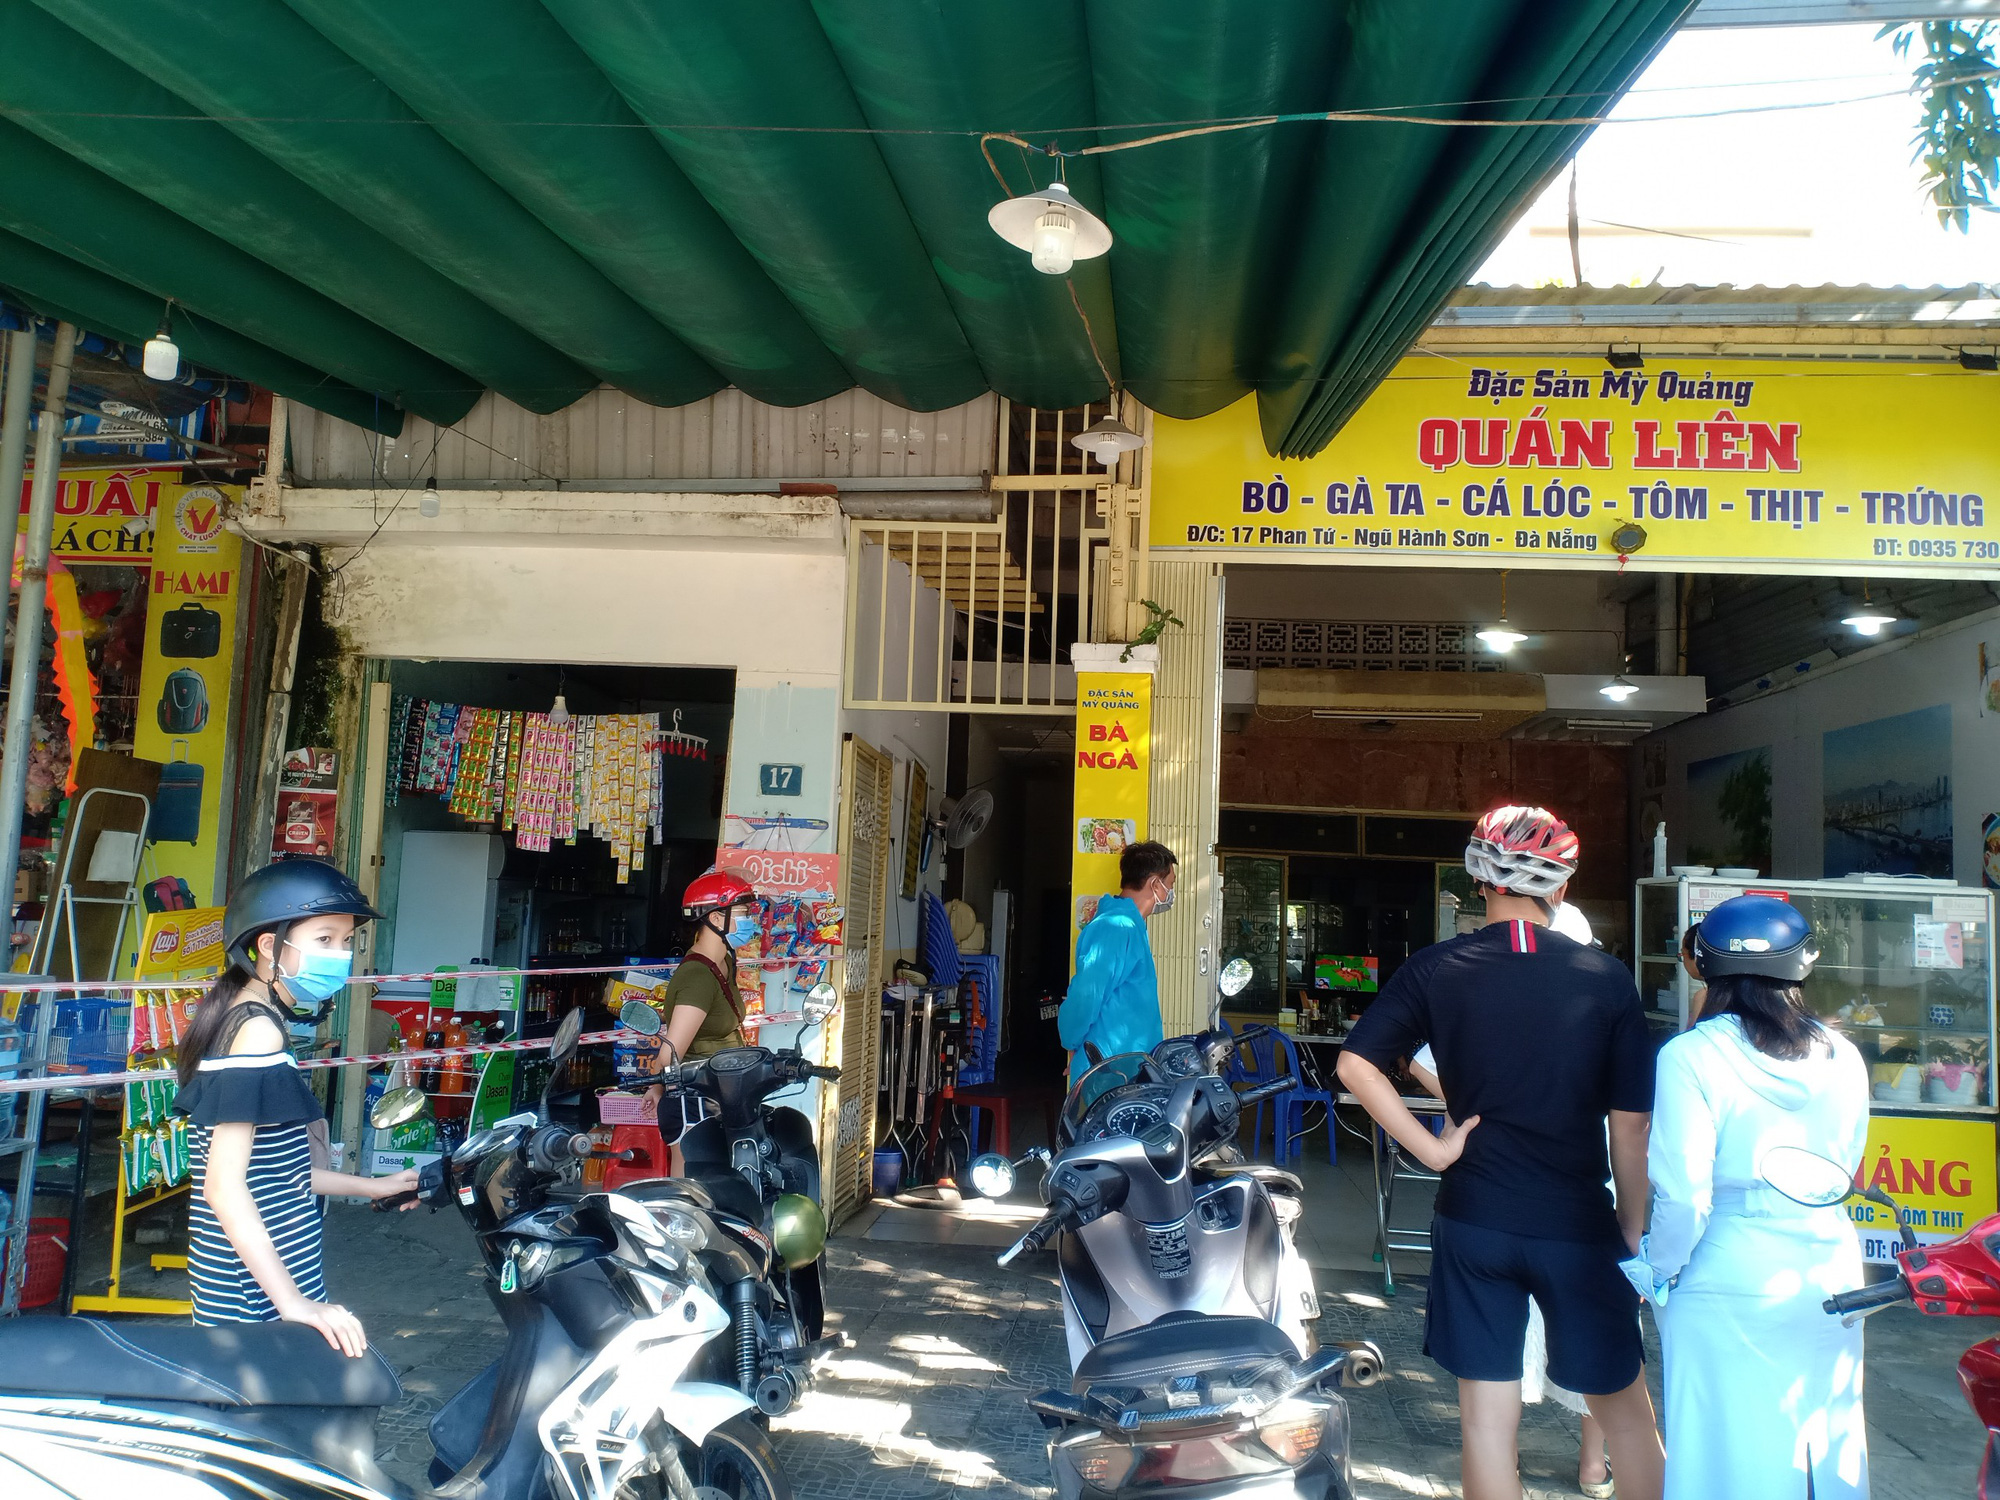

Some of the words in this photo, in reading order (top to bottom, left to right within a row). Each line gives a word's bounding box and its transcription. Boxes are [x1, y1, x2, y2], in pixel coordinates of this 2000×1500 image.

[1468, 369, 1524, 405] Đặc
[1533, 369, 1590, 399] Sản
[1599, 370, 1648, 405] Mỳ
[1656, 370, 1754, 407] Quảng
[1419, 405, 1612, 473] QUÁN
[1632, 409, 1802, 473] LIÊN
[1242, 474, 1289, 514] BÒ
[1326, 476, 1375, 516] GÀ
[1384, 483, 1425, 516] TA
[1462, 478, 1511, 518] CÁ
[1522, 478, 1592, 519] LÓC
[1628, 479, 1708, 520] TÔM
[1746, 488, 1825, 530] THỊT
[1861, 486, 1985, 527] TRỨNG
[1187, 525, 1225, 544] Đ/C:
[1231, 526, 1254, 543] 17
[1260, 526, 1307, 545] Phan
[1313, 525, 1336, 545] Tứ
[1354, 528, 1392, 549] Ngũ
[1398, 529, 1447, 548] Hành
[1453, 529, 1490, 548] Sơn
[1515, 530, 1540, 548] Đà
[1547, 528, 1597, 551] Nẵng
[1873, 538, 1902, 556] ĐT:
[1908, 539, 1957, 558] 0935
[1962, 541, 1999, 559] 730
[154, 570, 230, 595] HAMI
[1082, 699, 1099, 708] MỲ
[1101, 699, 1139, 710] QUẢNG
[1087, 688, 1109, 699] ĐẶC
[1111, 688, 1134, 698] SẢN
[1088, 720, 1129, 742] BÀ
[1078, 747, 1139, 770] NGÀ
[769, 767, 793, 788] 17
[1848, 1203, 1875, 1222] LÓC
[1896, 1206, 1927, 1226] ÔM
[1932, 1210, 1964, 1231] THỊT
[1865, 1239, 1886, 1259] ĐT:
